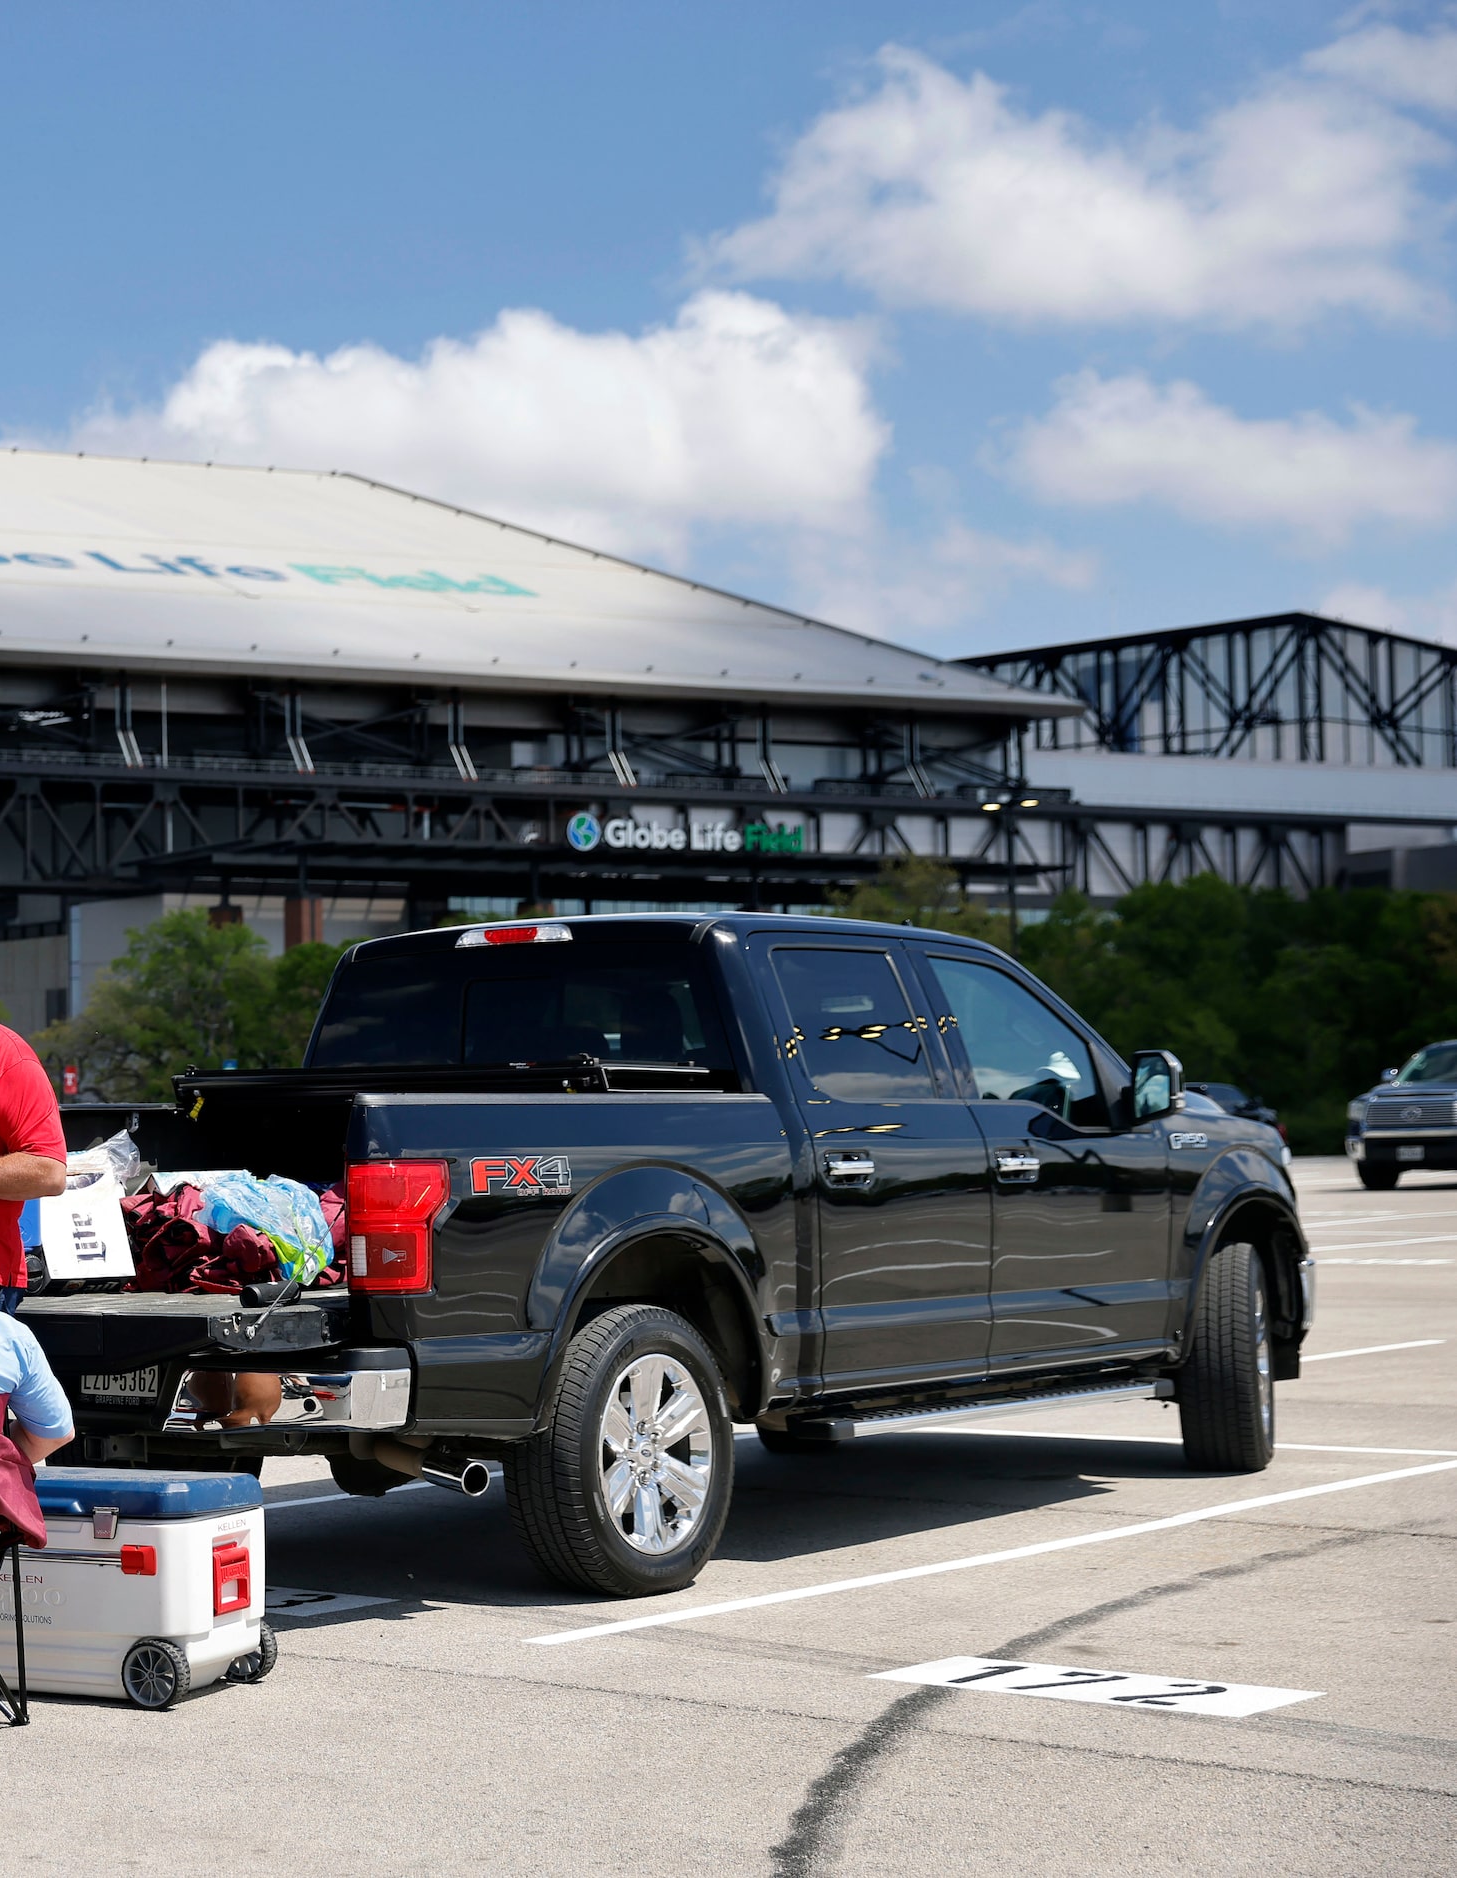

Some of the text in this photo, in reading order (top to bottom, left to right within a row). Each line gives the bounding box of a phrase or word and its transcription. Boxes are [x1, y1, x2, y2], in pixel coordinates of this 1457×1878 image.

[83, 550, 288, 581] Life
[286, 564, 540, 597] Field
[604, 819, 804, 853] Globe Life Field
[469, 1156, 571, 1195] FX4
[516, 1187, 572, 1196] OFF ROAD
[125, 1396, 140, 1406] FORD
[217, 1518, 247, 1532] KELLEN
[946, 1665, 1228, 1707] 172
